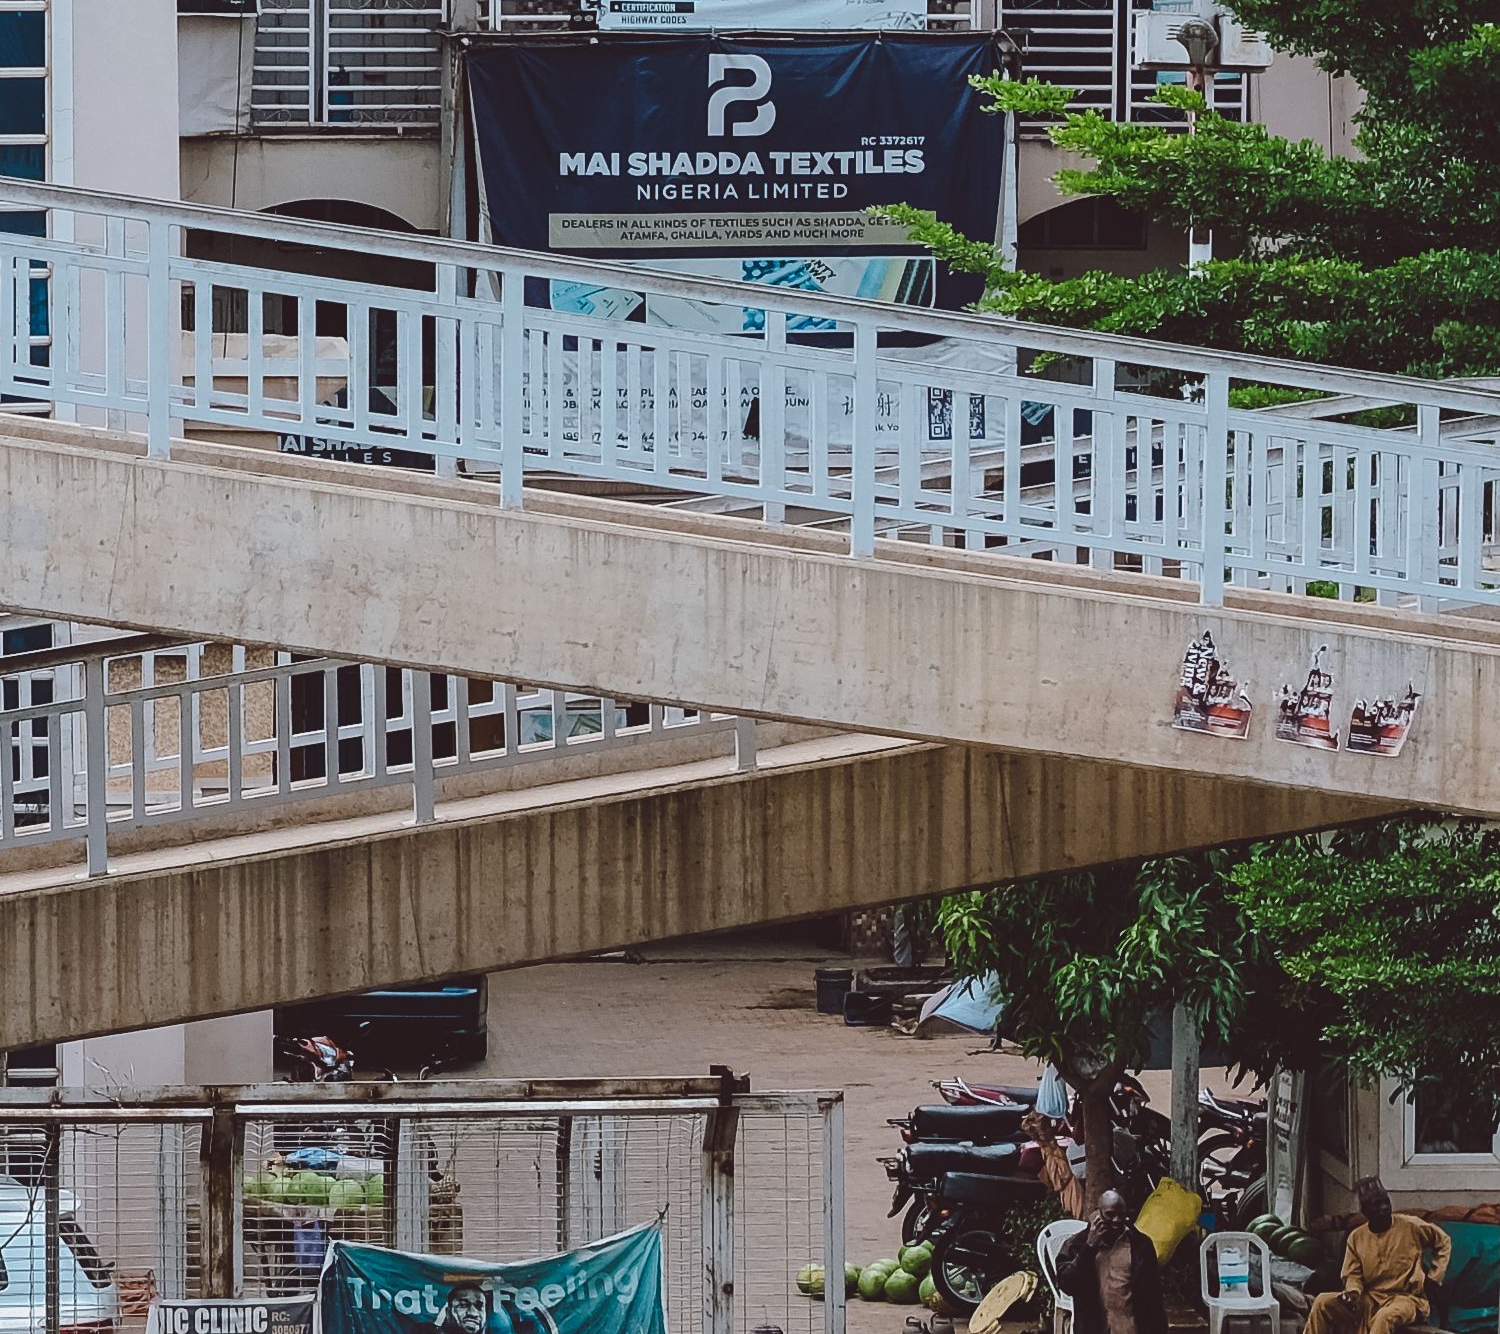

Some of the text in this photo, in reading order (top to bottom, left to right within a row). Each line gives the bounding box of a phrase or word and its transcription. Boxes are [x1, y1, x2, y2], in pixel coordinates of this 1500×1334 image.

[621, 3, 676, 13] CERTIFICATION
[621, 15, 687, 24] HIGHWAY CODES
[861, 136, 925, 146] RC 3372617
[559, 149, 925, 175] MAI SHADDA TEXTILES
[636, 183, 848, 200] NIGERIA LIMITED
[562, 216, 865, 229] DEALERS IN ALL KINDS OF TEXTILES SUCH AS SHADDA,
[620, 229, 864, 242] ATAMFA, GHALILA, YARDS AND MUCH MORE
[194, 1306, 268, 1334] CLINIC
